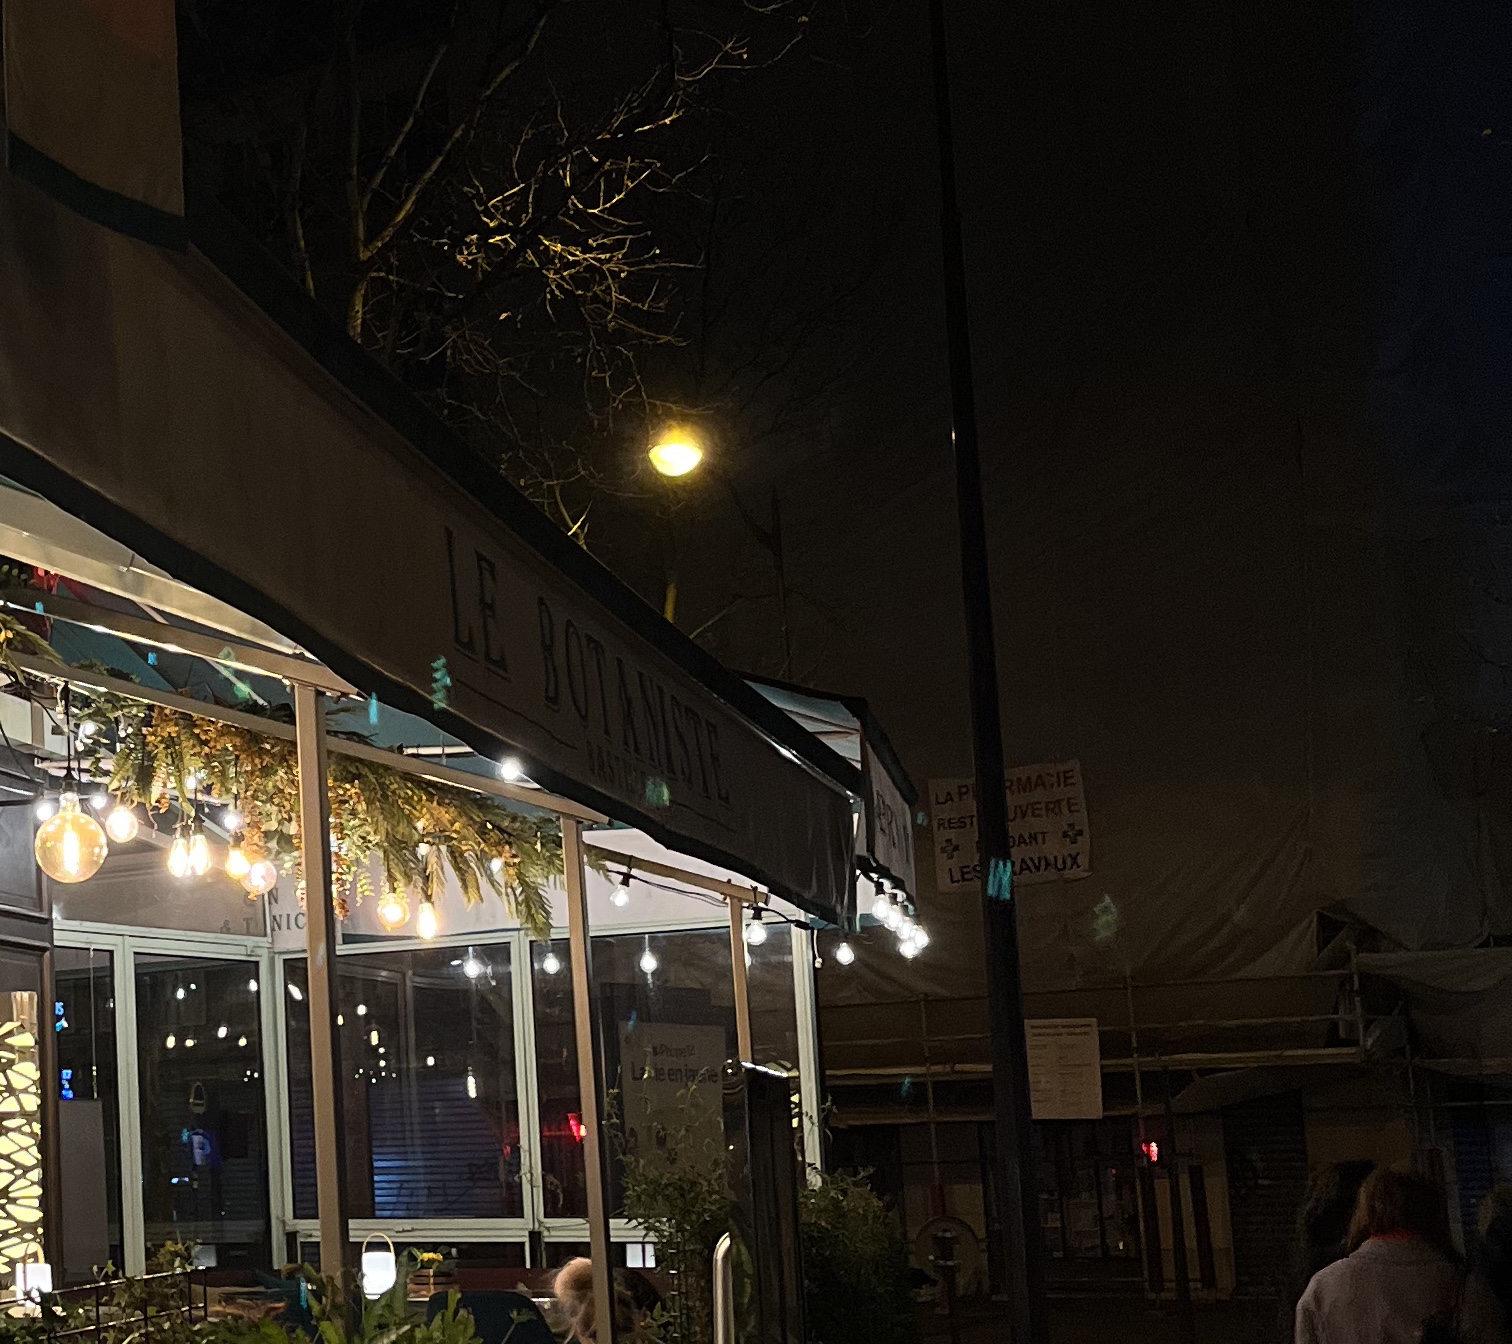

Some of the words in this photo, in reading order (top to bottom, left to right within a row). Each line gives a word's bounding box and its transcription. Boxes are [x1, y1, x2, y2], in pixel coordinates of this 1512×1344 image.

[444, 525, 511, 683] LE
[537, 595, 733, 810] BOTANISTE
[934, 791, 955, 805] LA
[936, 814, 977, 832] REST
